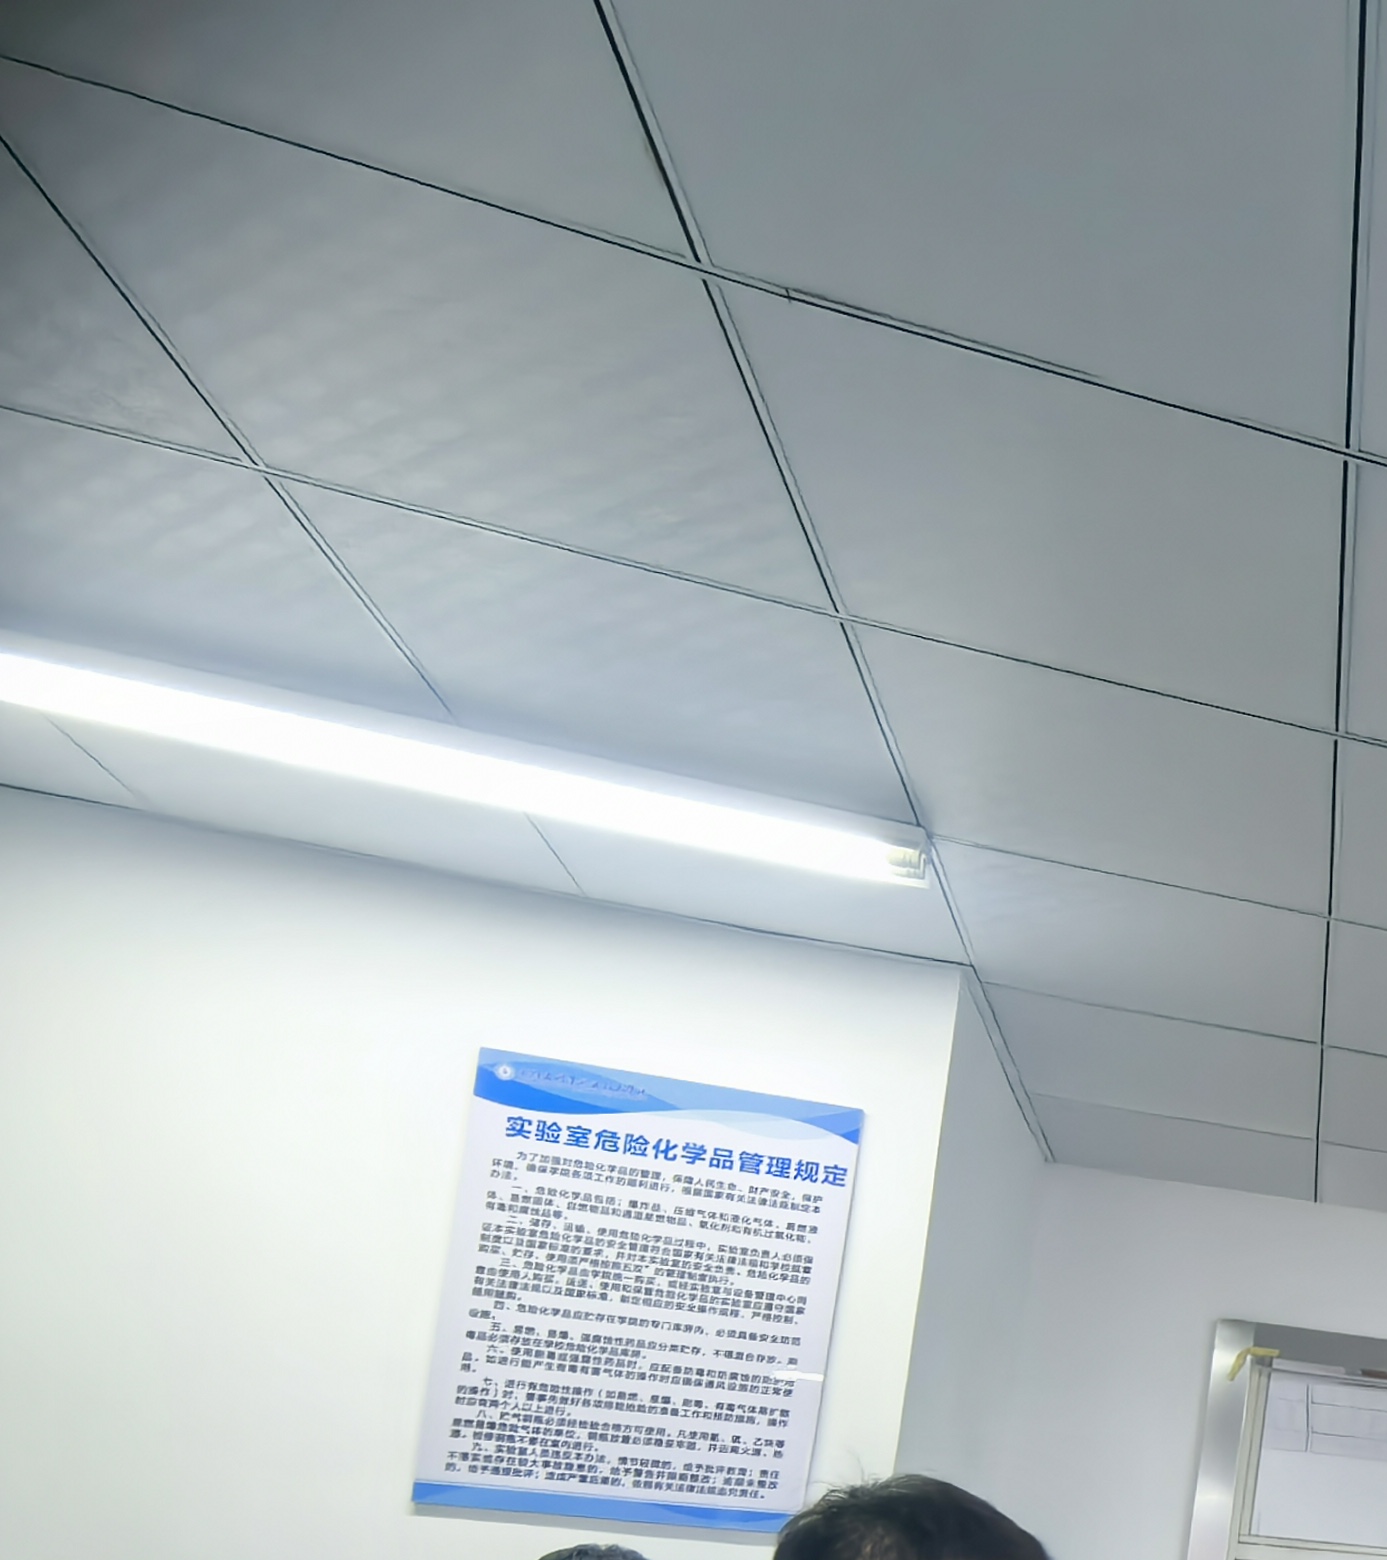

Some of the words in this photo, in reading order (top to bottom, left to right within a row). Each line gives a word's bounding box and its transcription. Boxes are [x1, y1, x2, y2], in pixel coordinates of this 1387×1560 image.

[505, 1115, 848, 1187] 实验室危险化学品管理规定
